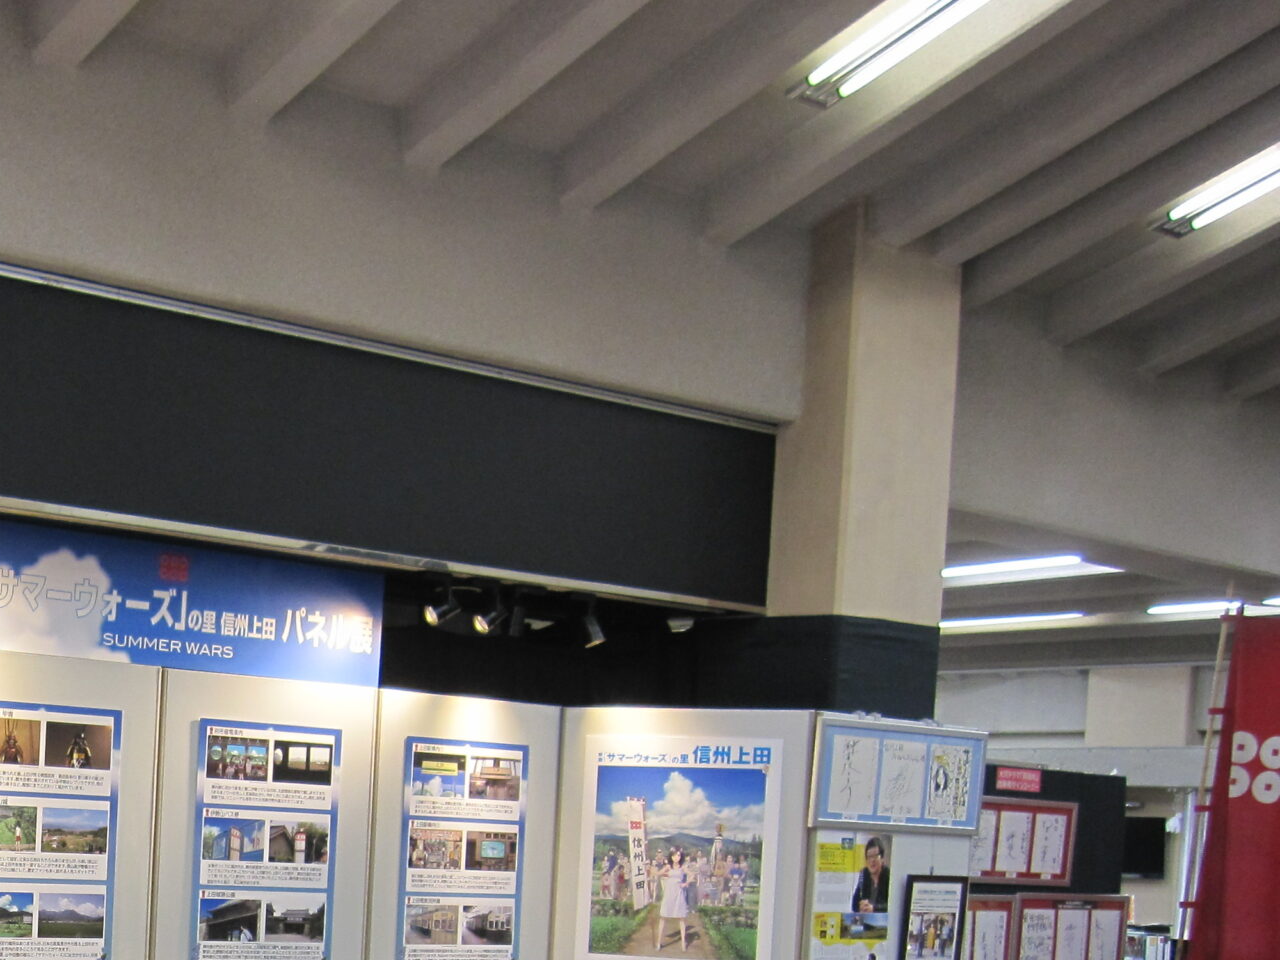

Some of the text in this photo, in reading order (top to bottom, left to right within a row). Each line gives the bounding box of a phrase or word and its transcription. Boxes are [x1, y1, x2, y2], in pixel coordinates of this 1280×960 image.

[220, 611, 276, 642] 信州上田
[103, 631, 234, 659] SUMMER WARS
[692, 745, 772, 765] 信州上田
[631, 836, 646, 891] 信州上田
